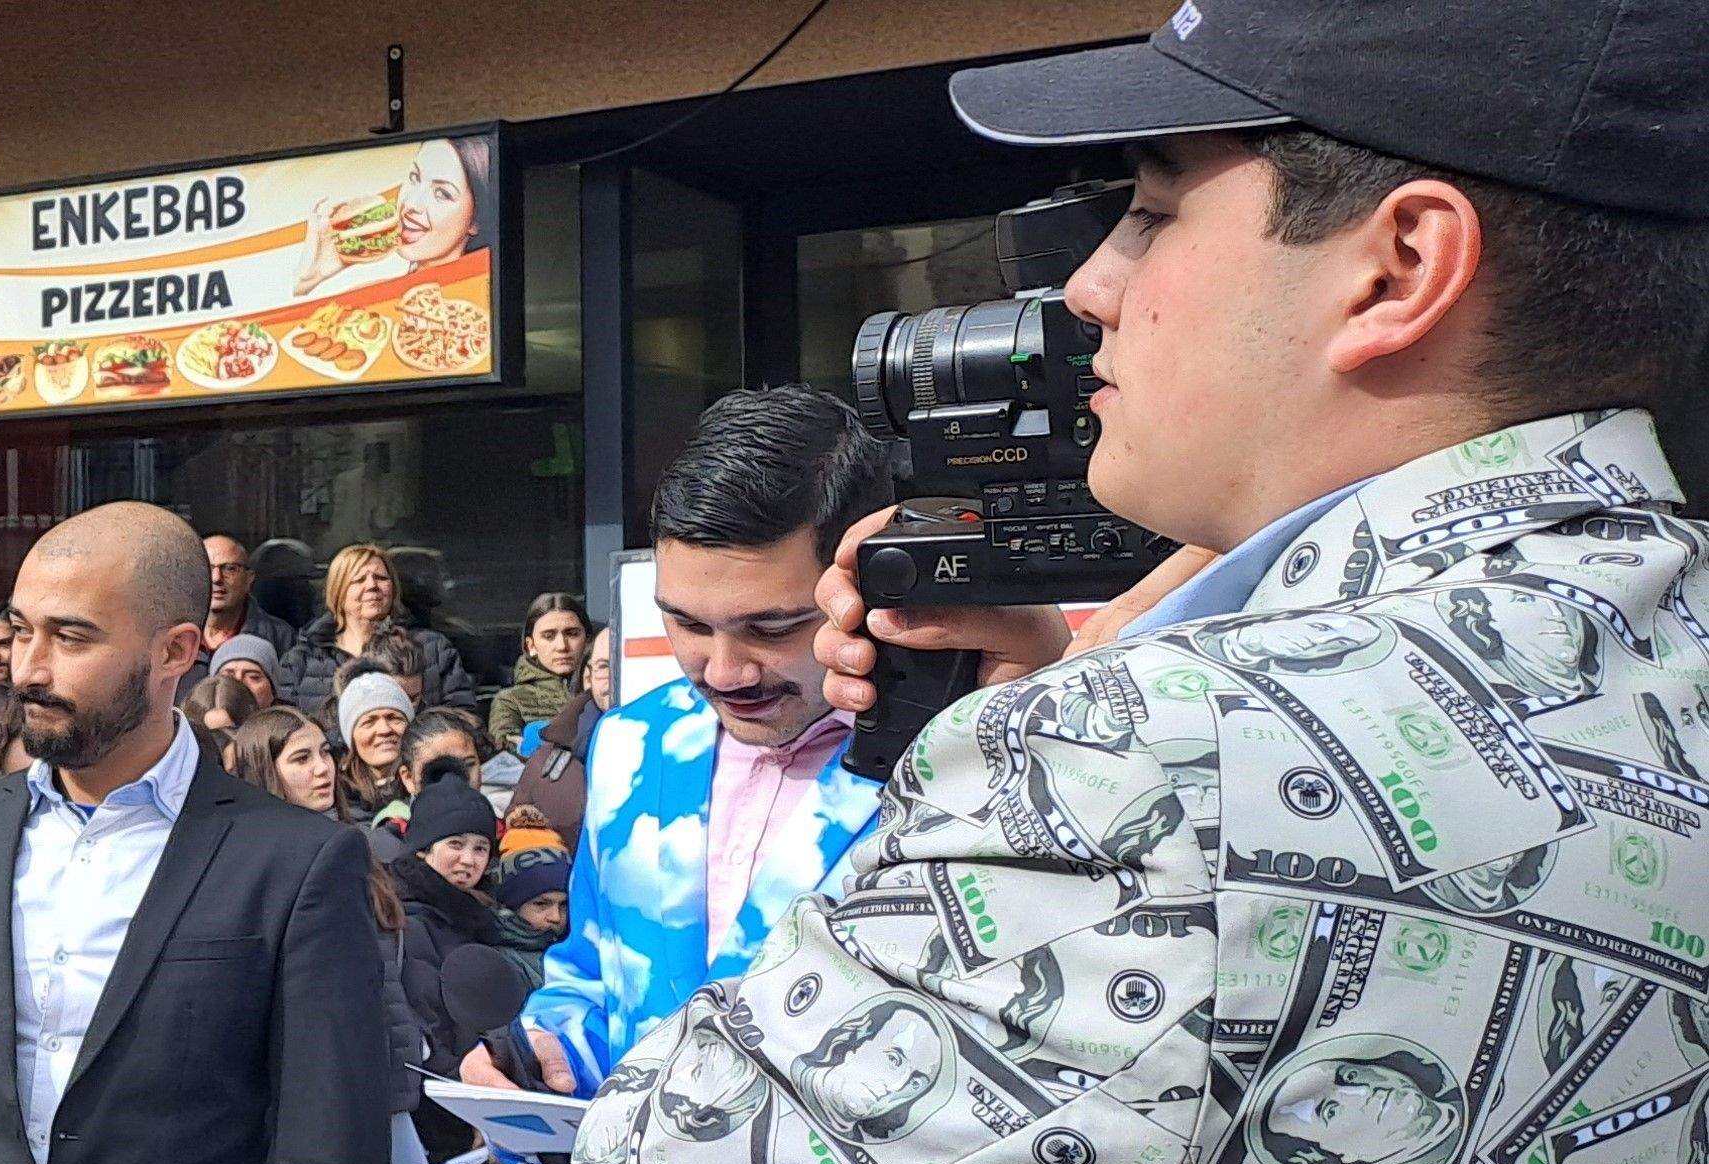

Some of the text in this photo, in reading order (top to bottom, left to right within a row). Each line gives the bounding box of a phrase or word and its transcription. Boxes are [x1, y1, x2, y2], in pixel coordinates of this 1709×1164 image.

[31, 175, 246, 251] ENKEBAB
[41, 268, 233, 328] PIZZERIA
[992, 447, 1028, 463] CCD
[1396, 509, 1530, 551] 100
[934, 555, 967, 577] AF
[1485, 704, 1575, 812] 100
[1617, 765, 1709, 805] 100
[1378, 771, 1438, 853] 100
[1250, 848, 1358, 887] 100
[956, 872, 998, 943] 100
[1094, 912, 1194, 939] 100
[1515, 912, 1705, 984] ONE HUNDRED DOLLARS
[1650, 919, 1706, 959] 100
[1485, 945, 1524, 1048] HUNDRED
[1572, 1095, 1672, 1146] 100
